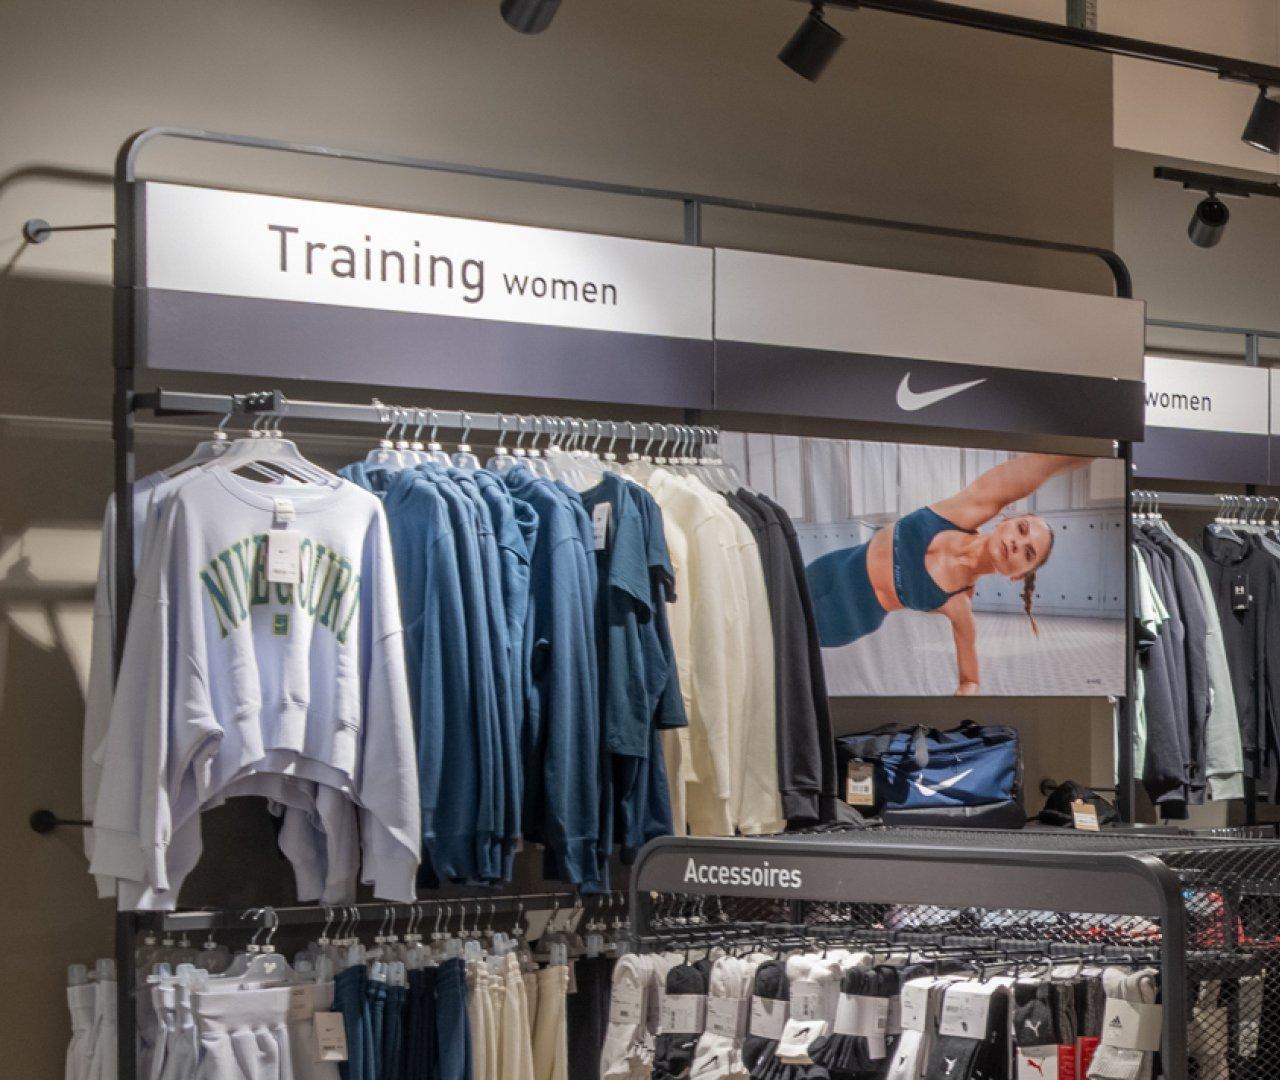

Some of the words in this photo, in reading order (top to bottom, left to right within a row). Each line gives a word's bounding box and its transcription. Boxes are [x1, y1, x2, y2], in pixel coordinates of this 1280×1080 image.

[268, 224, 485, 304] Training
[502, 272, 618, 305] women
[1144, 391, 1212, 412] women
[683, 858, 802, 889] Accessoires
